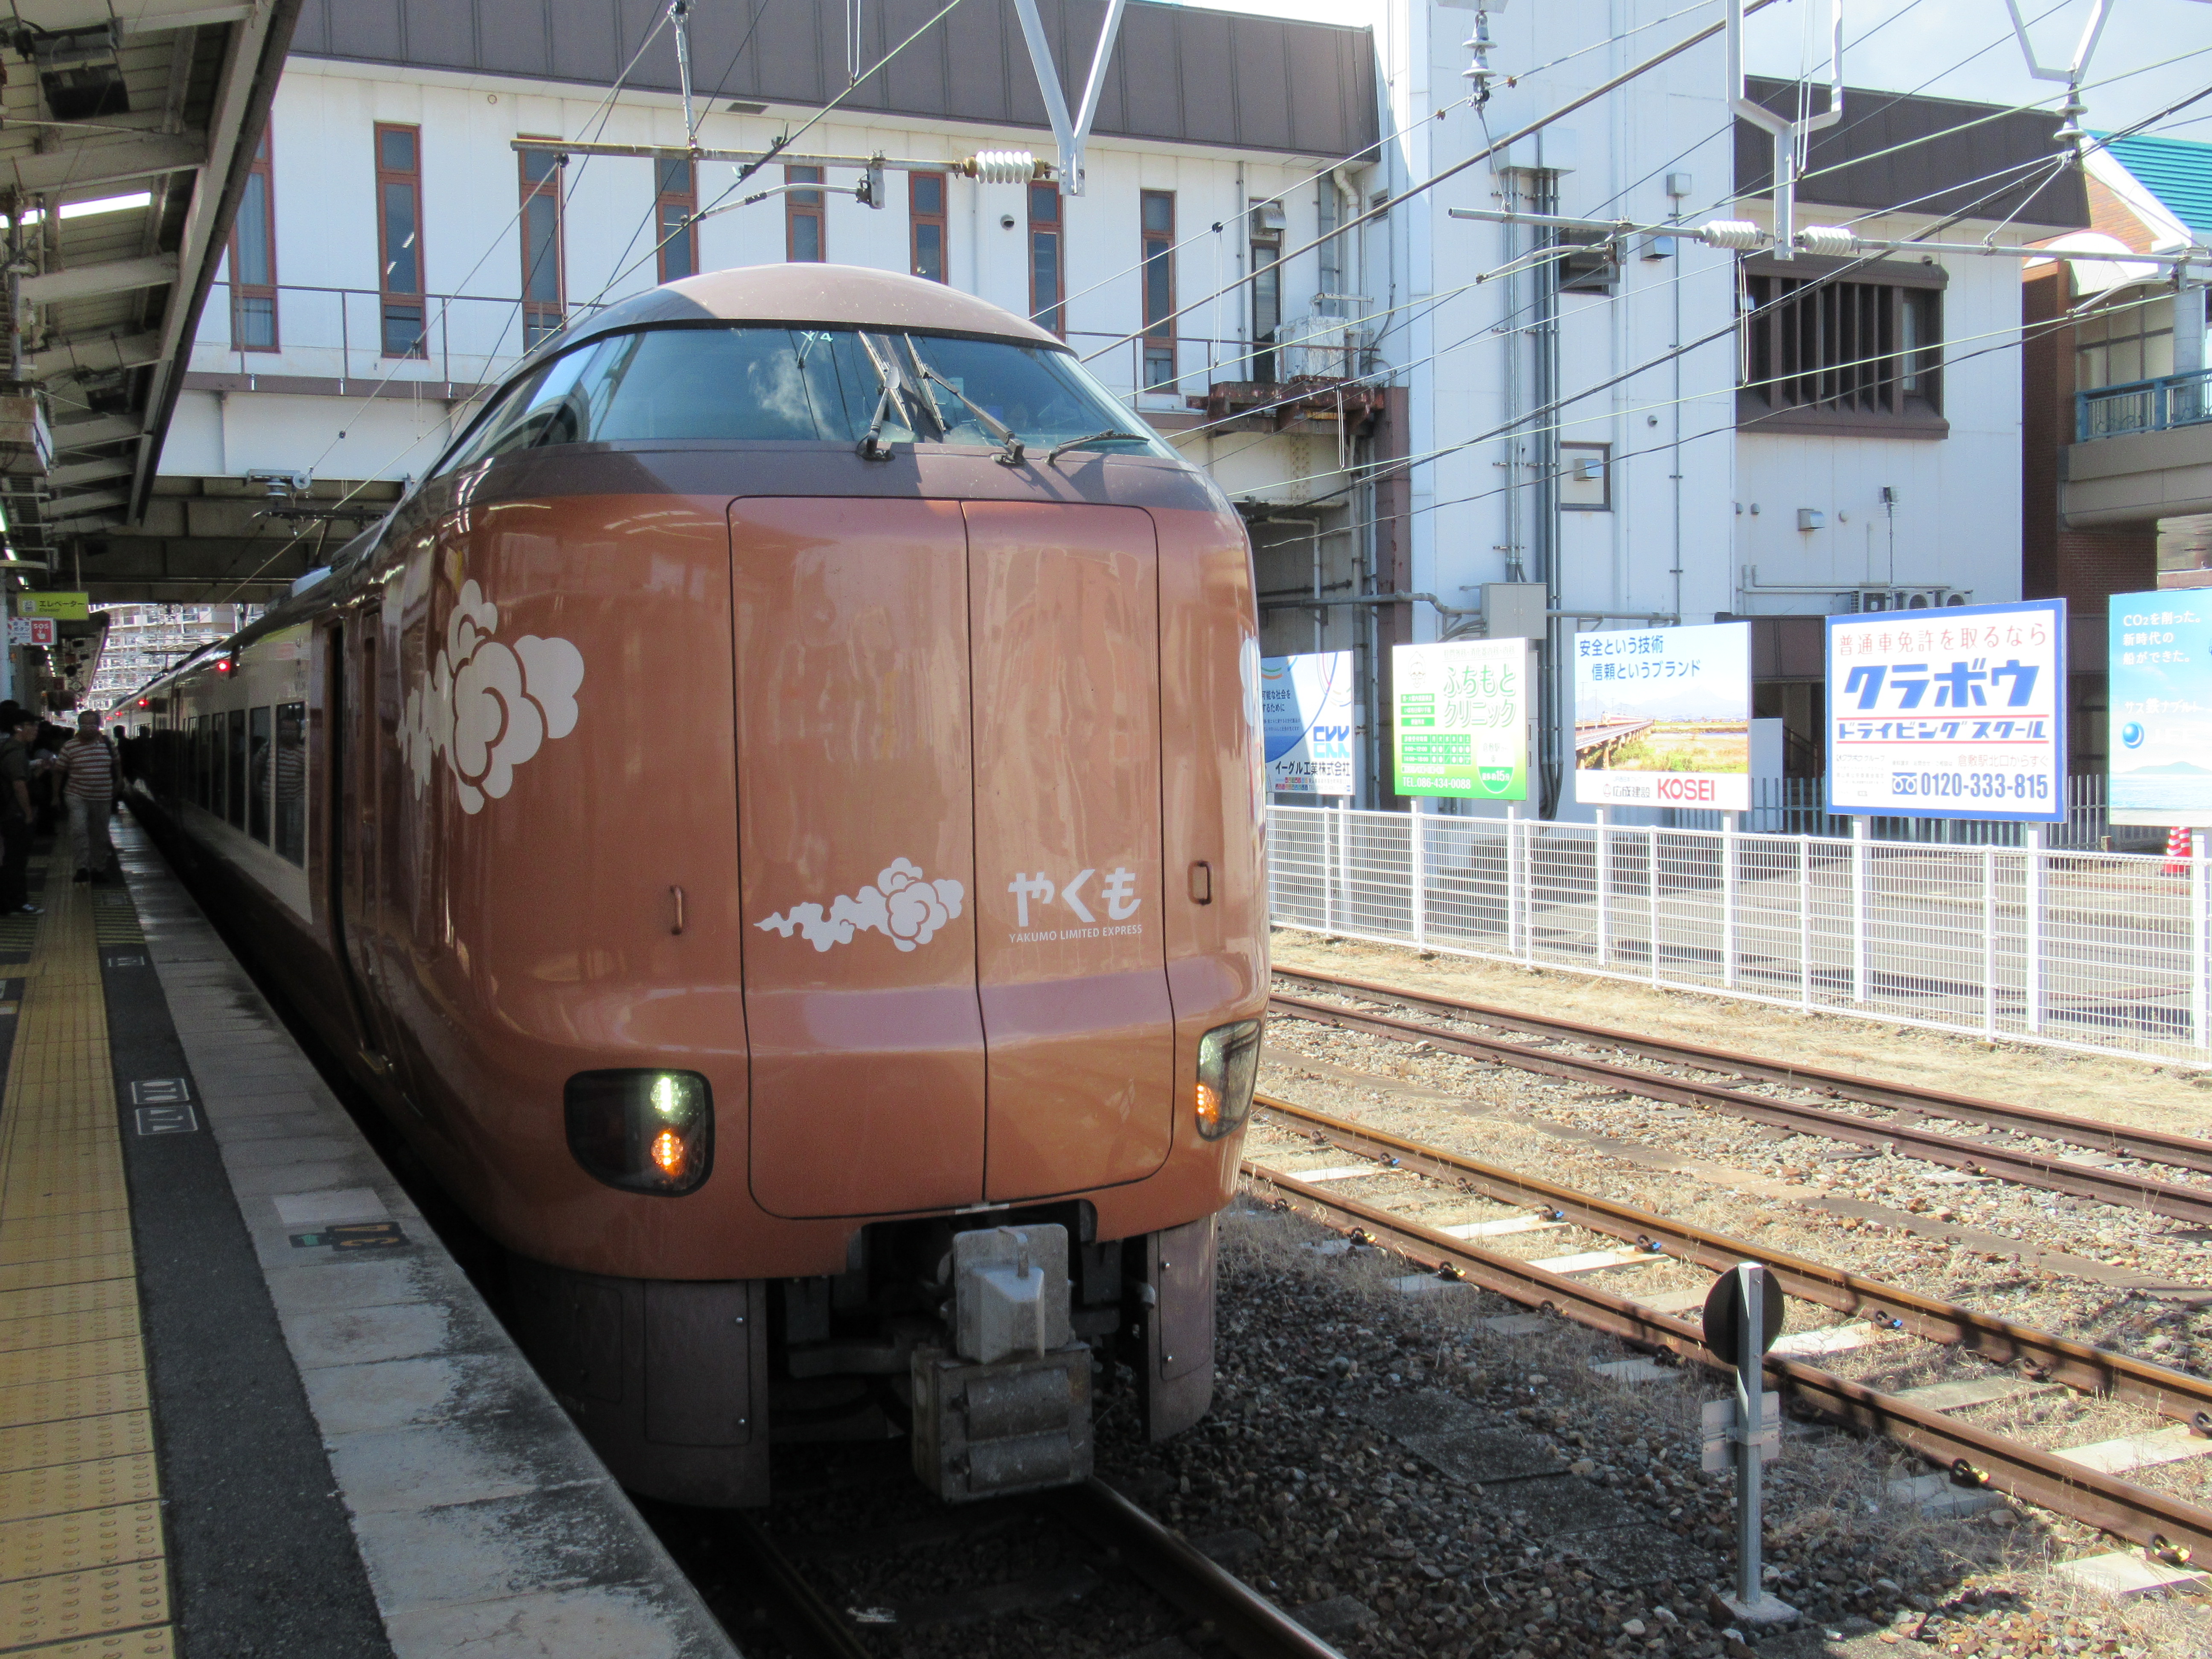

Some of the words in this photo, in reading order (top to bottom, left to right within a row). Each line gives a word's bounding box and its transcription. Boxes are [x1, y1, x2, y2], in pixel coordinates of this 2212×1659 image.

[1580, 635, 1664, 657] 安全という技術
[1839, 623, 2046, 656] 普通車免許を取るなら
[2122, 632, 2174, 646] 新時代の
[2122, 649, 2190, 666] 船ができた。
[1443, 662, 1516, 699] ふちもと
[1591, 659, 1701, 681] 信頼というブランド
[1844, 658, 2040, 710] クラボウ
[1443, 699, 1516, 728] クリニック
[1839, 720, 2046, 739] ドライビングスクール
[1275, 760, 1350, 776] イーグル工業株式会社
[1957, 754, 2048, 767] 倉敷駅北口からすぐ
[1403, 777, 1471, 789] TEL.086-434-0088
[1612, 786, 1650, 798] 広成建設
[1657, 778, 1715, 801] KOSEI
[1921, 771, 2048, 800] 0120-333-815
[1007, 867, 1142, 927] やくも
[1008, 930, 1057, 943] YAKUMO
[1060, 928, 1100, 940] LIMITED
[1103, 924, 1142, 936] EXPRESS
